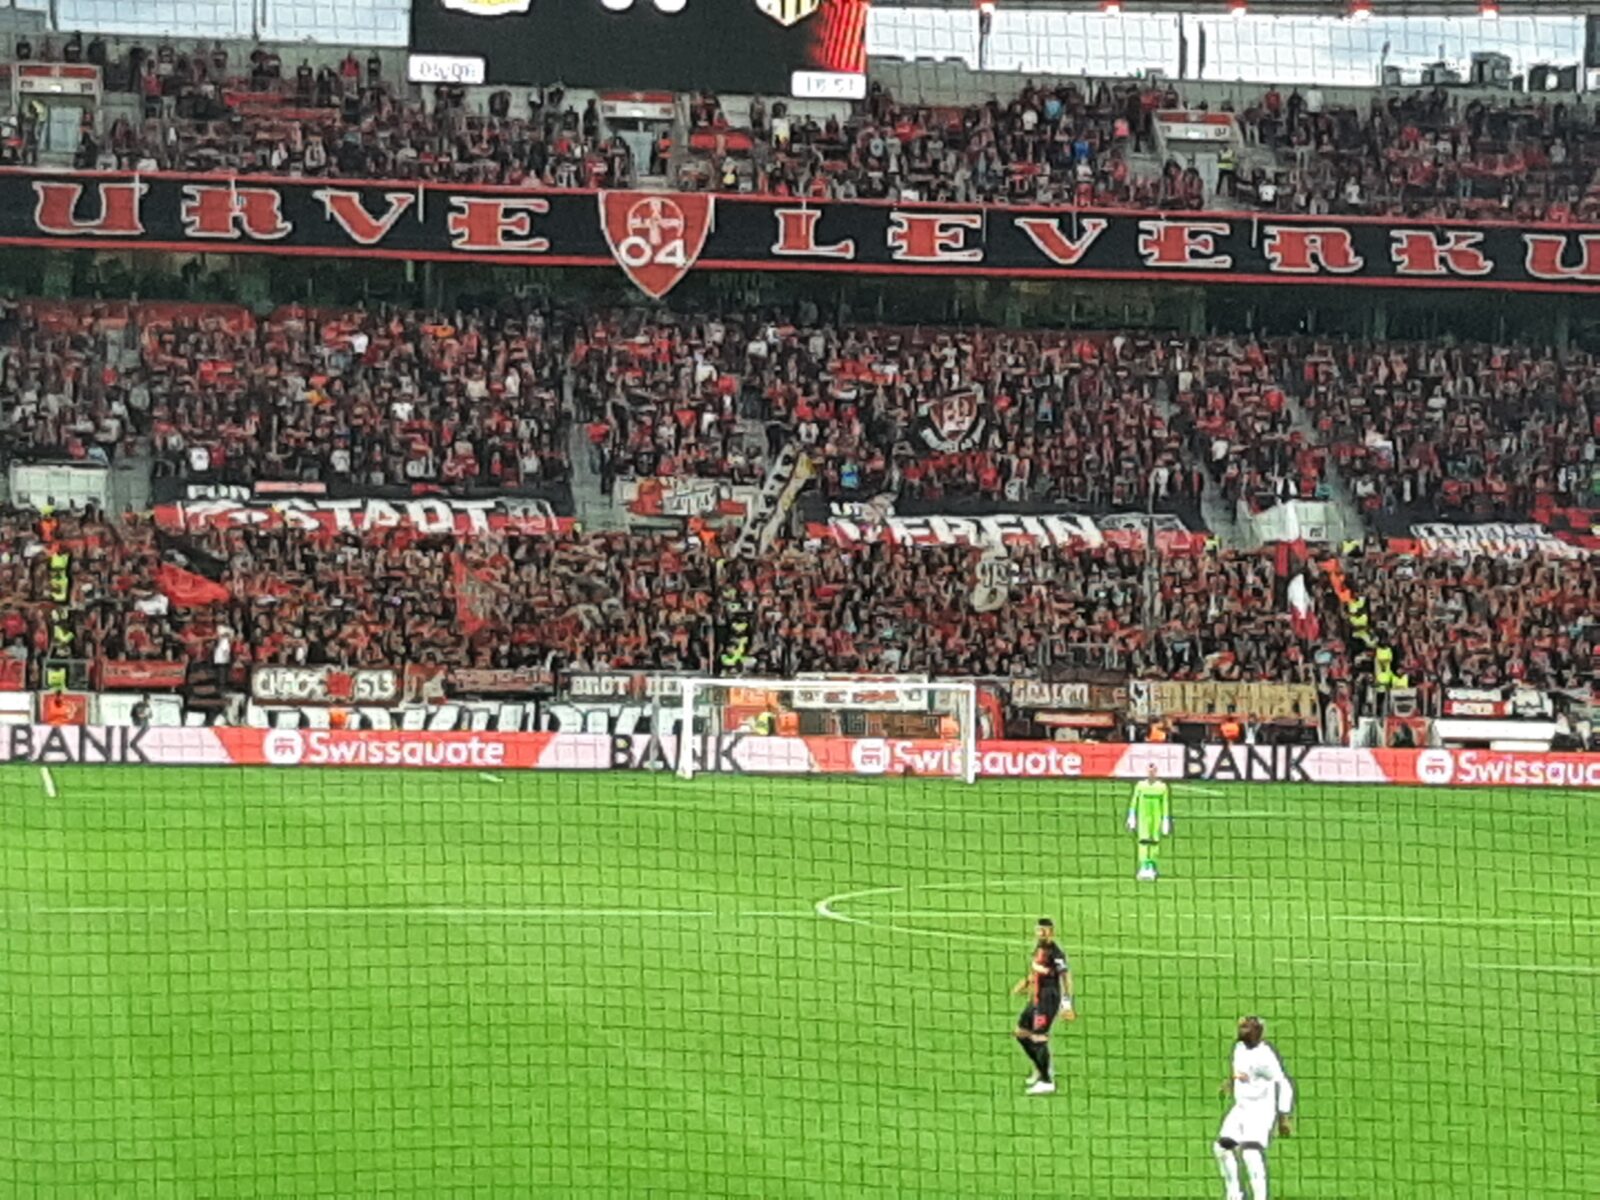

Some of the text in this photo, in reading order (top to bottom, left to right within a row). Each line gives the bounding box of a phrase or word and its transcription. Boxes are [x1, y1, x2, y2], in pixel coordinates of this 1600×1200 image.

[619, 236, 687, 270] 04
[771, 208, 1600, 279] LEVERKU
[10, 725, 150, 763] BANK
[309, 732, 504, 765] Swissquote
[611, 734, 743, 771] BANK
[1184, 744, 1314, 780] BANK
